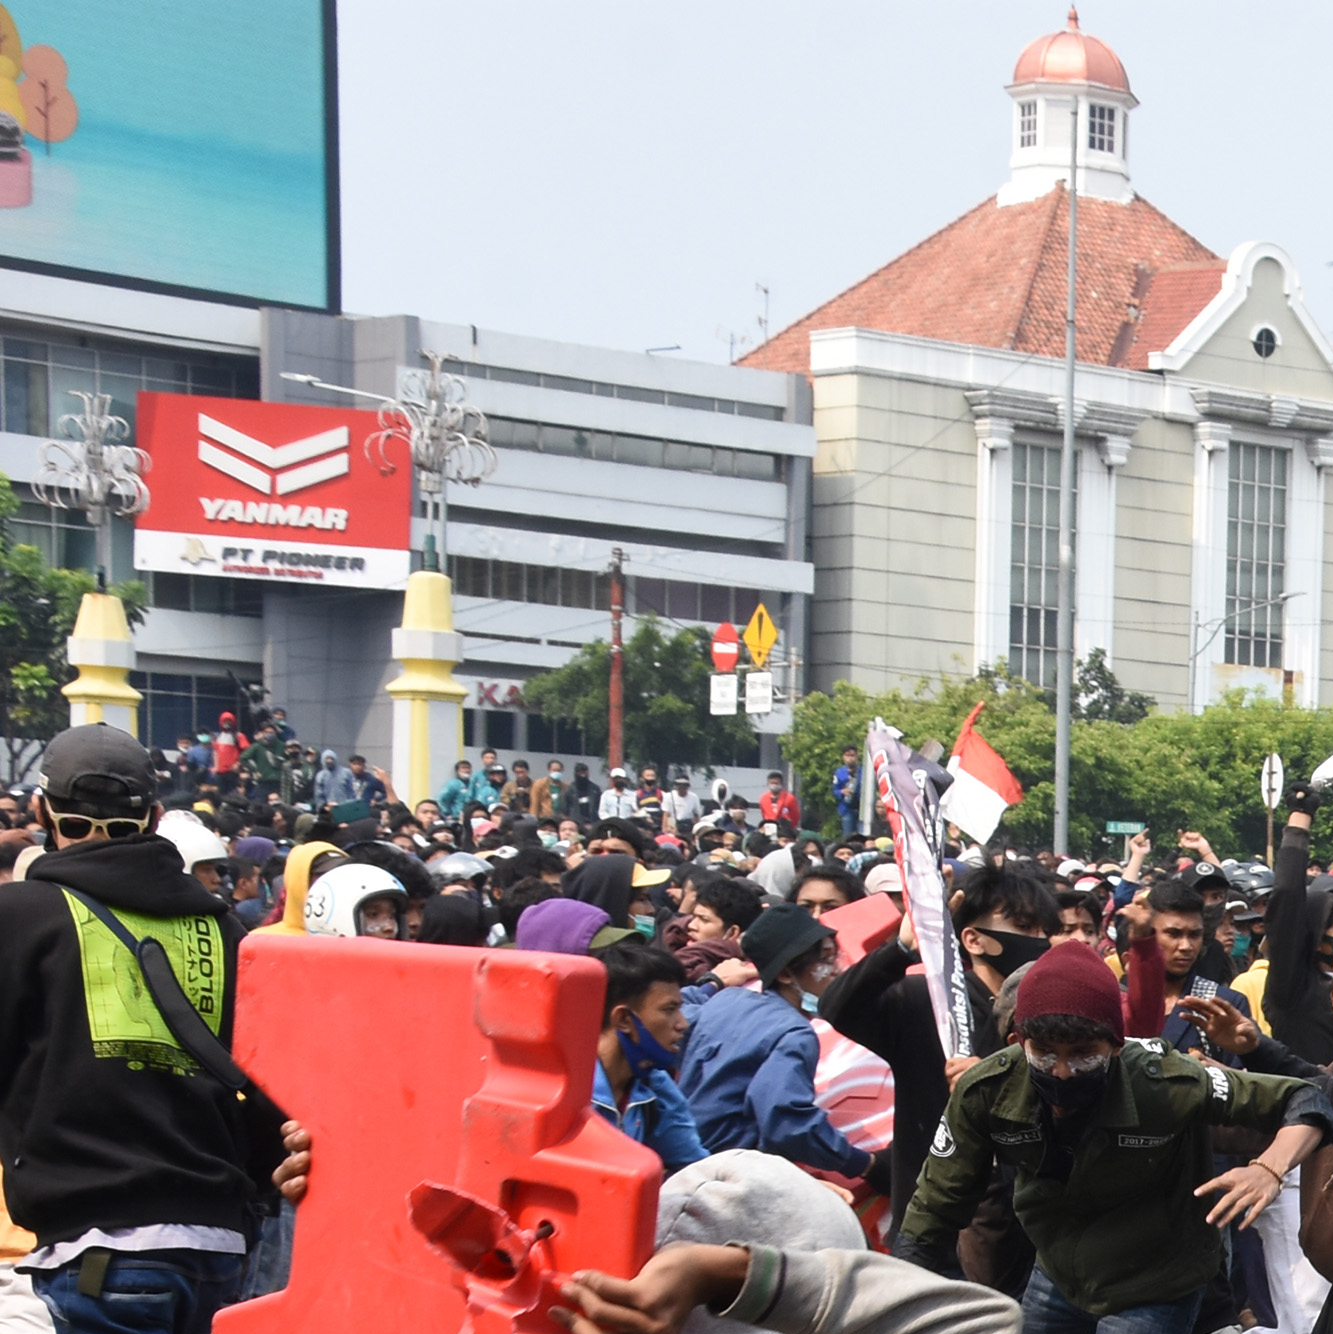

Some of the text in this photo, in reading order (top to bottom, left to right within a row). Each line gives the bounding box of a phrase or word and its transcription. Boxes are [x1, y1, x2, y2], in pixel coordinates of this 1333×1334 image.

[199, 497, 349, 531] YANMAR
[222, 547, 365, 571] PT PIONEER
